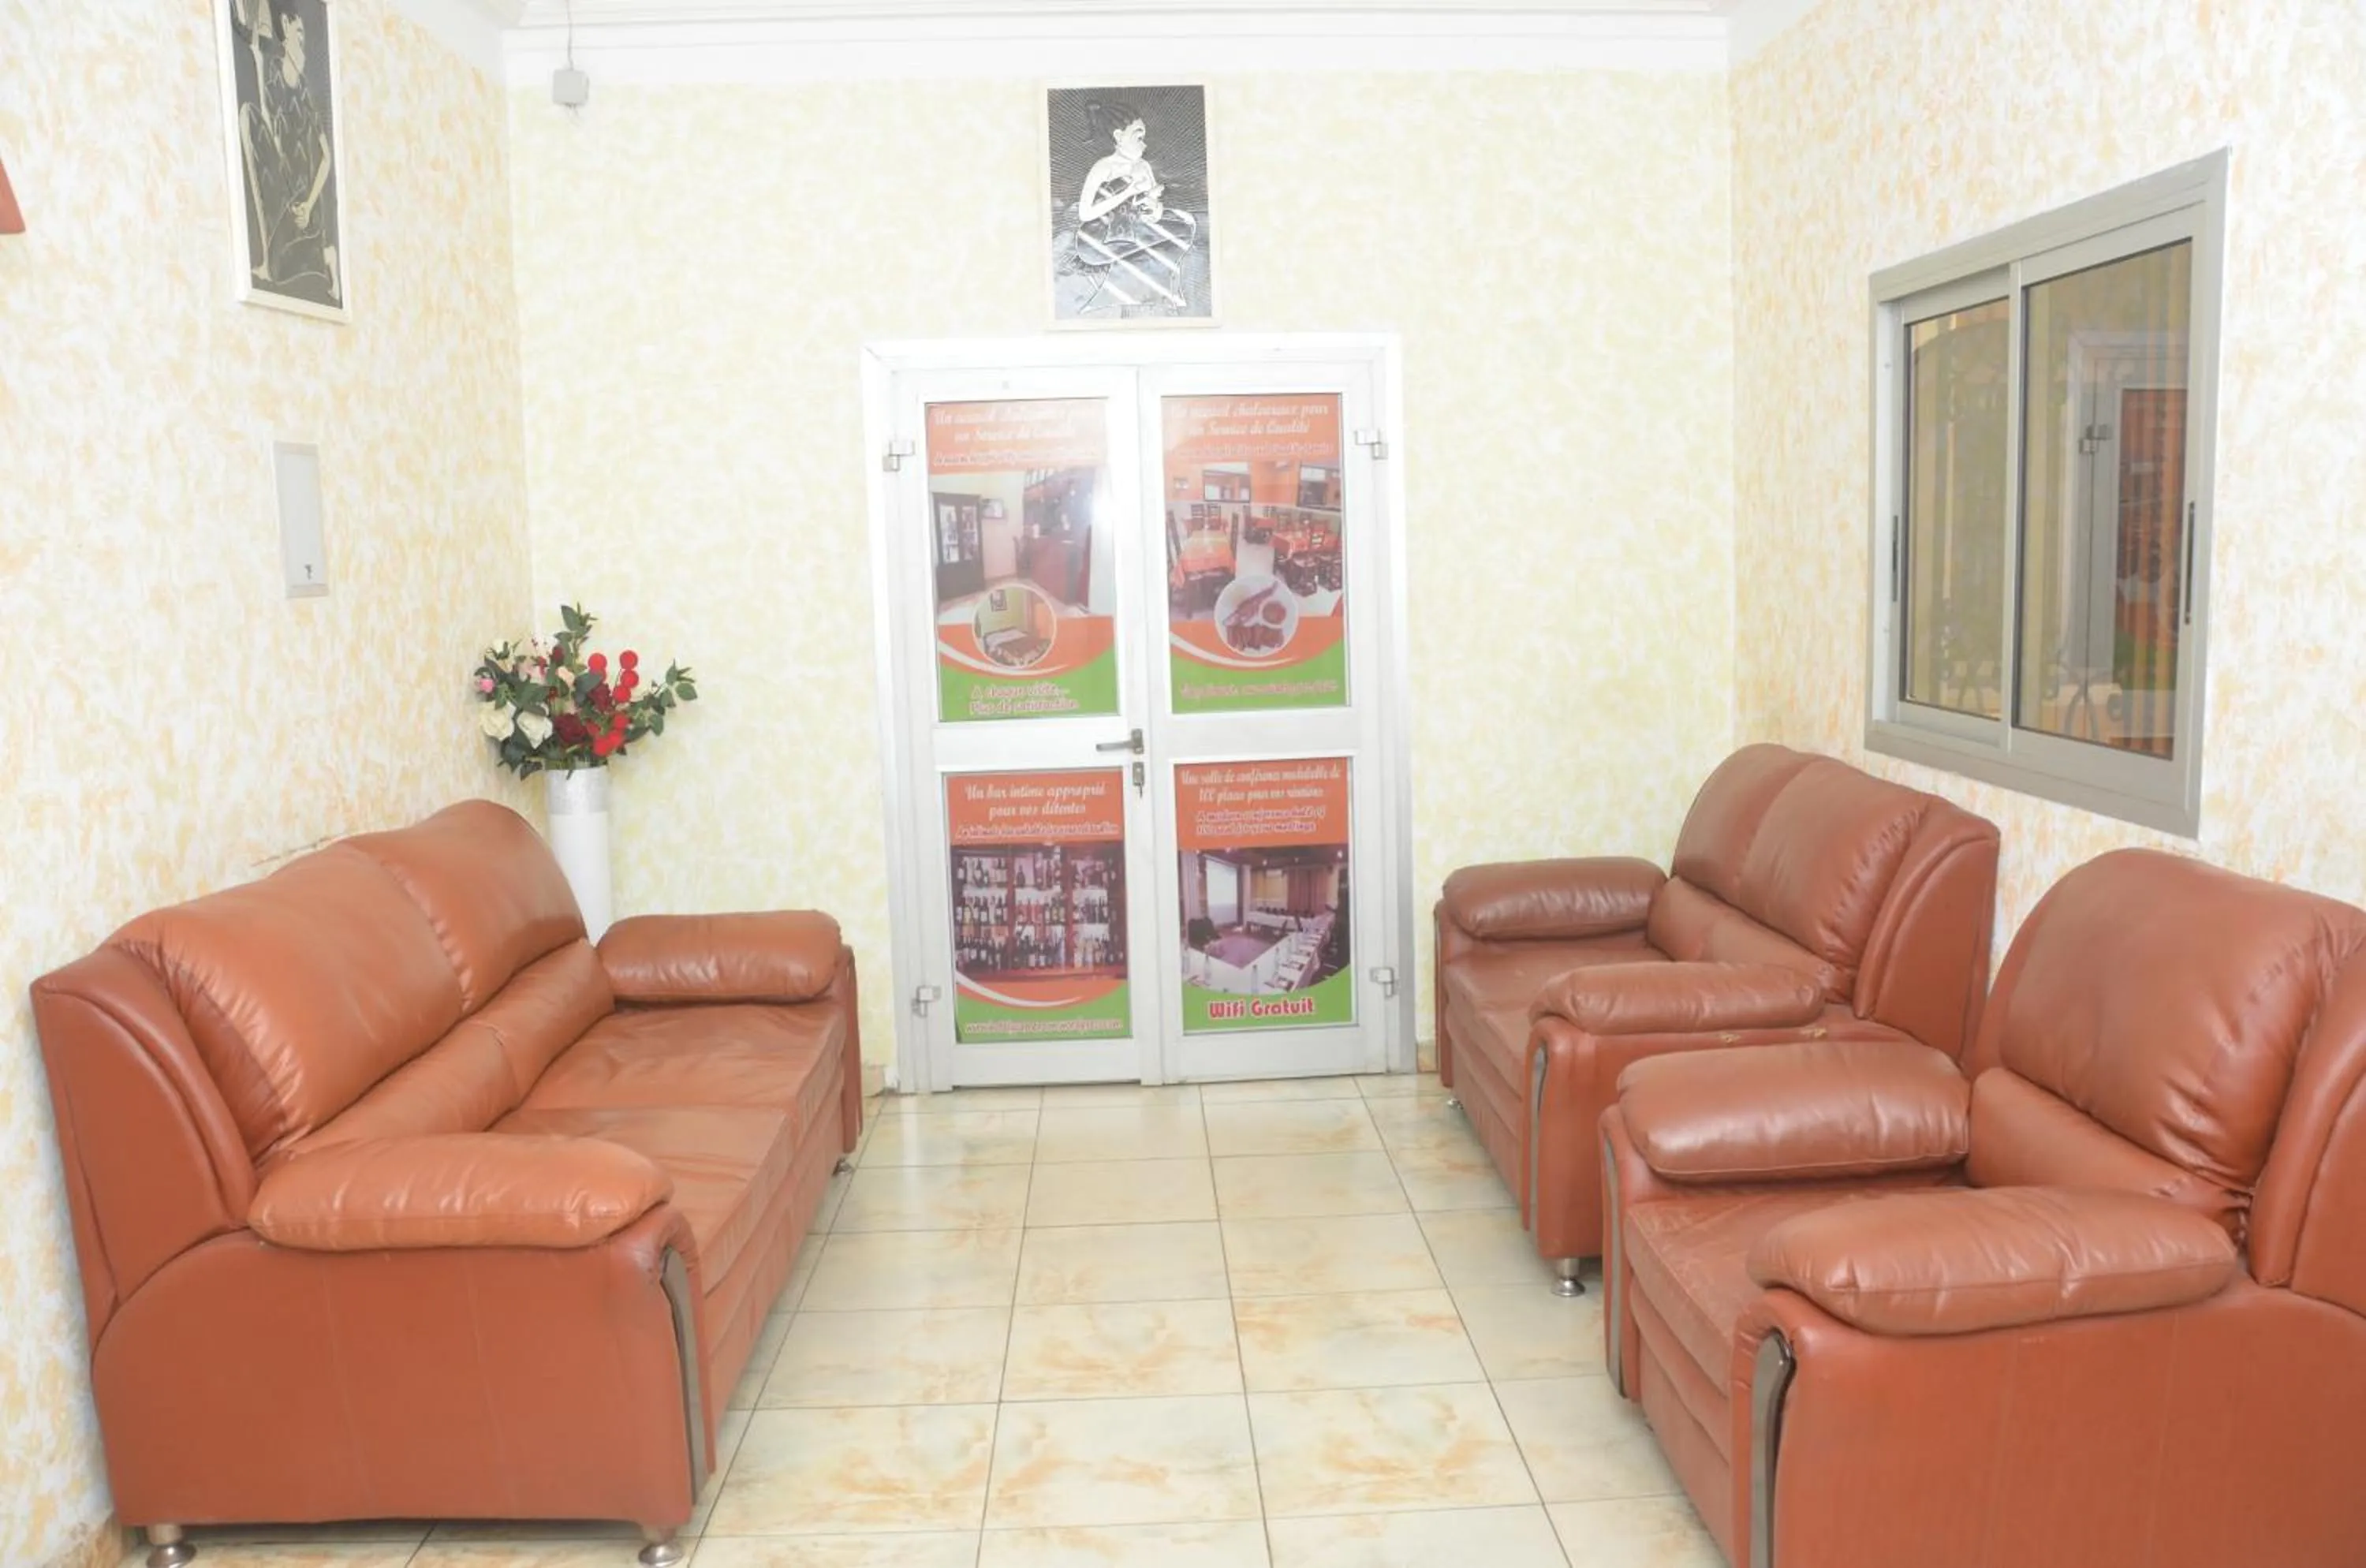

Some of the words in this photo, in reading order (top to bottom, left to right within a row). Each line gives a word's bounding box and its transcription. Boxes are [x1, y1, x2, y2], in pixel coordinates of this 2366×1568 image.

[966, 783, 984, 801] Un
[987, 783, 1006, 799] bar
[1010, 782, 1043, 797] intime
[988, 805, 1016, 820] pour
[1207, 999, 1245, 1019] Wifi
[1250, 997, 1315, 1017] Gratuit
